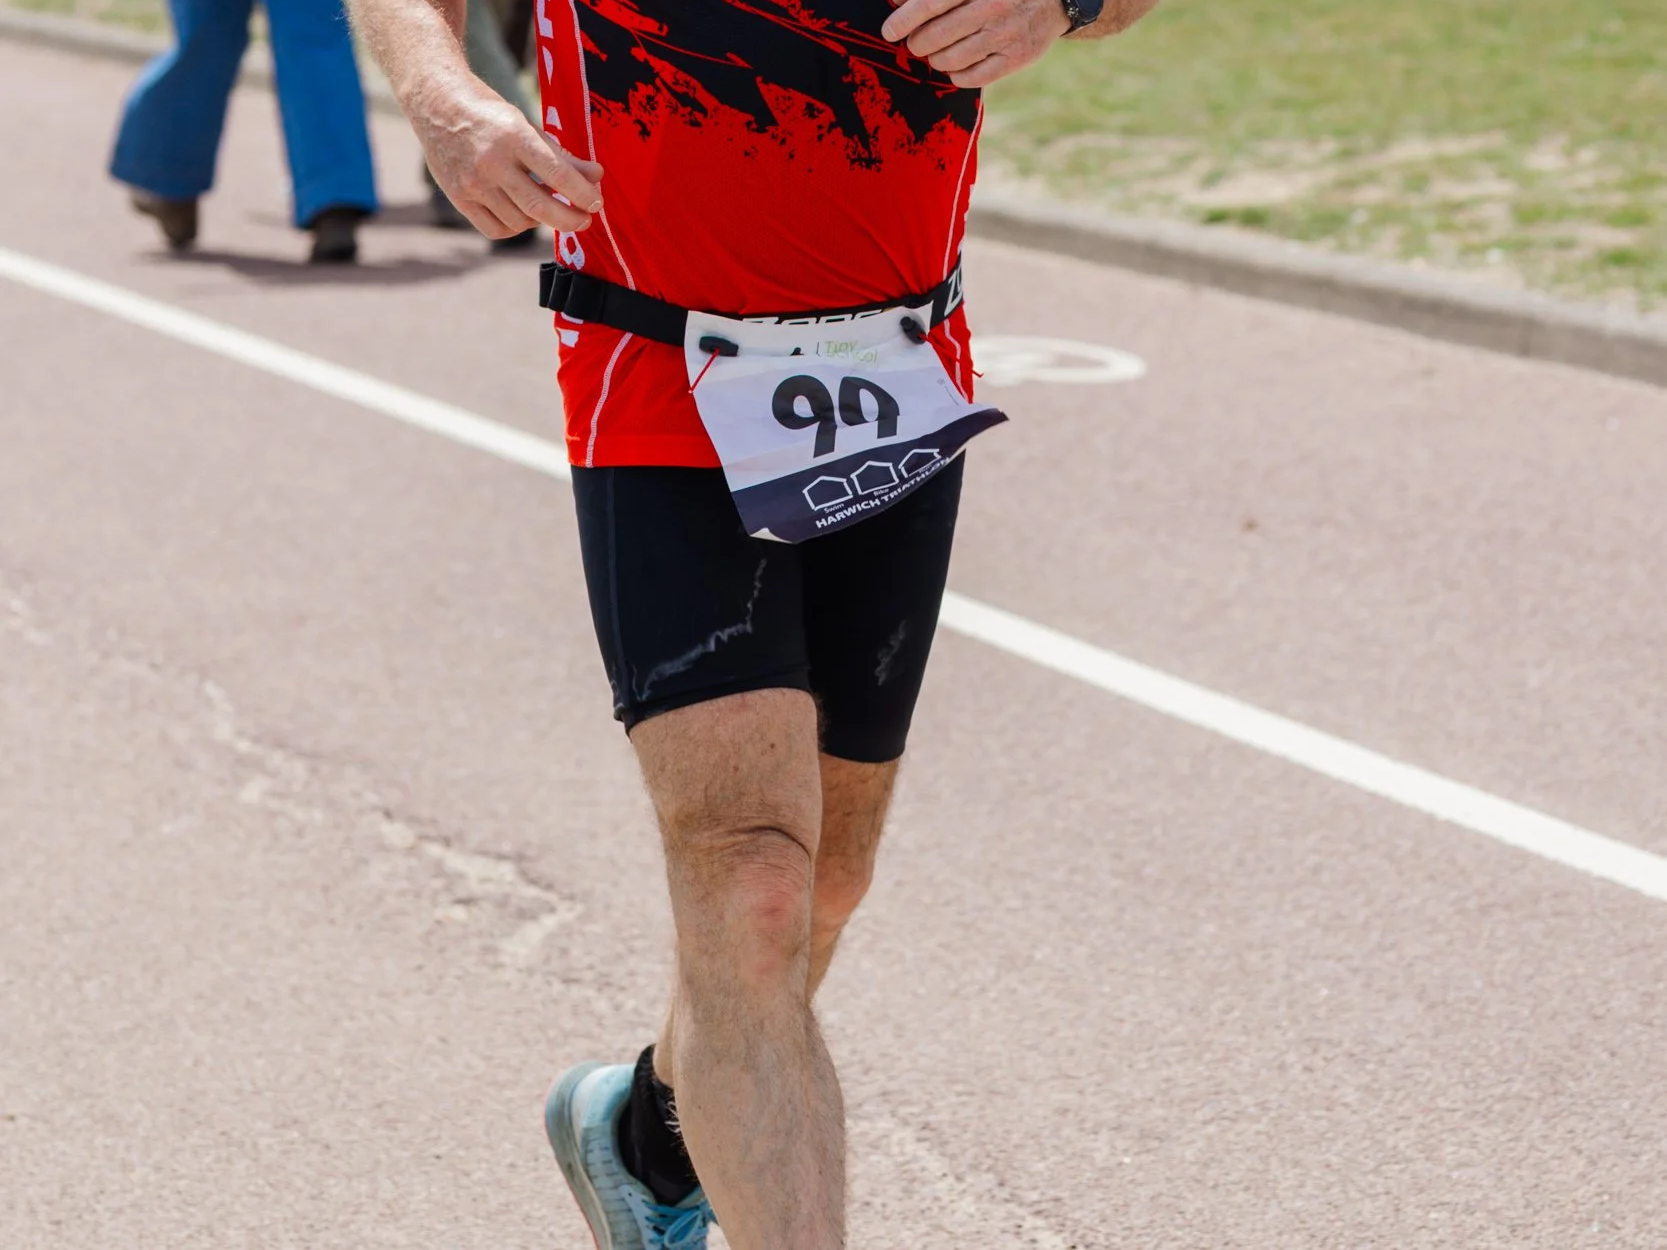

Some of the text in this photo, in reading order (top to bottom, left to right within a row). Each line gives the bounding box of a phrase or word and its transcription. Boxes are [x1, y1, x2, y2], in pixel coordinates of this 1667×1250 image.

[815, 456, 951, 529] HARWICH TRIATHLON
[823, 503, 845, 514] Swim
